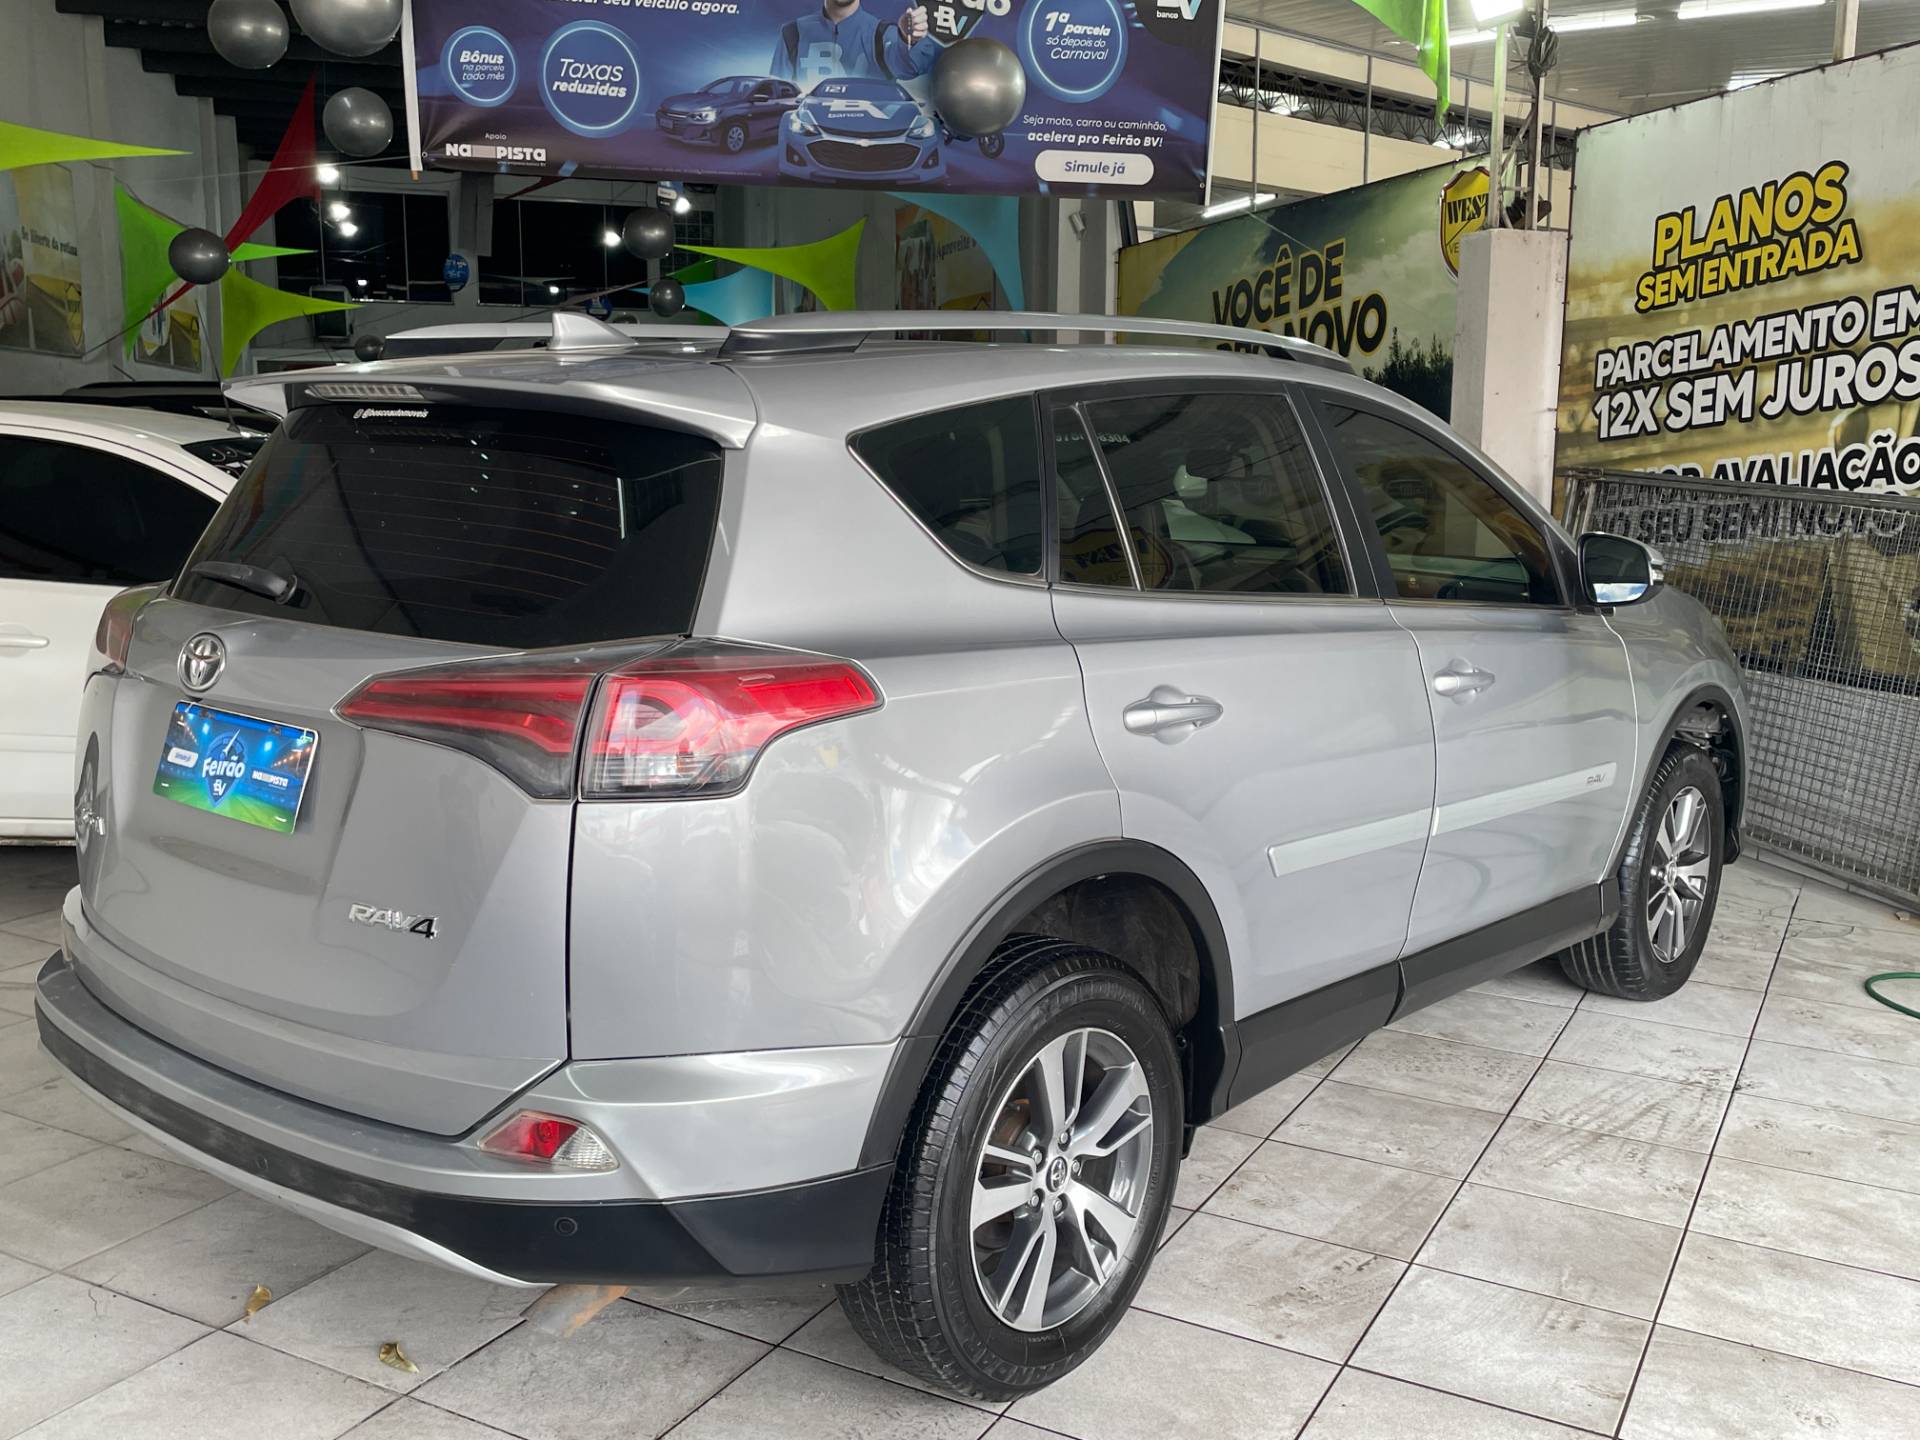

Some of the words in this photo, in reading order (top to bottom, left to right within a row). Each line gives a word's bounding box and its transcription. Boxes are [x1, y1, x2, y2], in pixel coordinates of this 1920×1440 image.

[691, 2, 740, 15] agora.
[1156, 9, 1179, 19] banco
[1063, 18, 1111, 37] parcela
[1045, 35, 1058, 46] só
[1060, 36, 1093, 49] depois
[1093, 38, 1106, 48] do
[460, 50, 504, 64] Bônus
[1050, 47, 1109, 60] Carnaval
[462, 64, 474, 72] na
[474, 64, 505, 73] parcela
[487, 70, 505, 81] mês
[560, 58, 624, 82] Taxas
[553, 79, 628, 98] reduzidas
[1023, 114, 1044, 127] Seja
[1045, 116, 1073, 128] moto,
[1076, 118, 1103, 128] carro
[1104, 120, 1117, 129] ou
[1118, 121, 1168, 132] caminhão,
[1027, 130, 1076, 144] acelera
[1077, 133, 1100, 146] pro
[1102, 133, 1141, 147] Feirão
[1143, 136, 1163, 148] BV!
[1064, 160, 1110, 175] Simule
[1110, 161, 1126, 177] já
[1653, 161, 1849, 269] PLANOS
[1635, 268, 1697, 313] SEM
[1699, 221, 1860, 298] ENTRADA
[1213, 243, 1292, 328] VOCÊ
[1299, 238, 1347, 310] DE
[1595, 297, 1867, 389] PARCELAMENTO
[1594, 384, 1661, 439] 12X
[1665, 368, 1756, 431] SEM
[1761, 339, 1920, 418] JUROS
[202, 756, 246, 778] Feirão
[349, 903, 438, 940] RAV4
